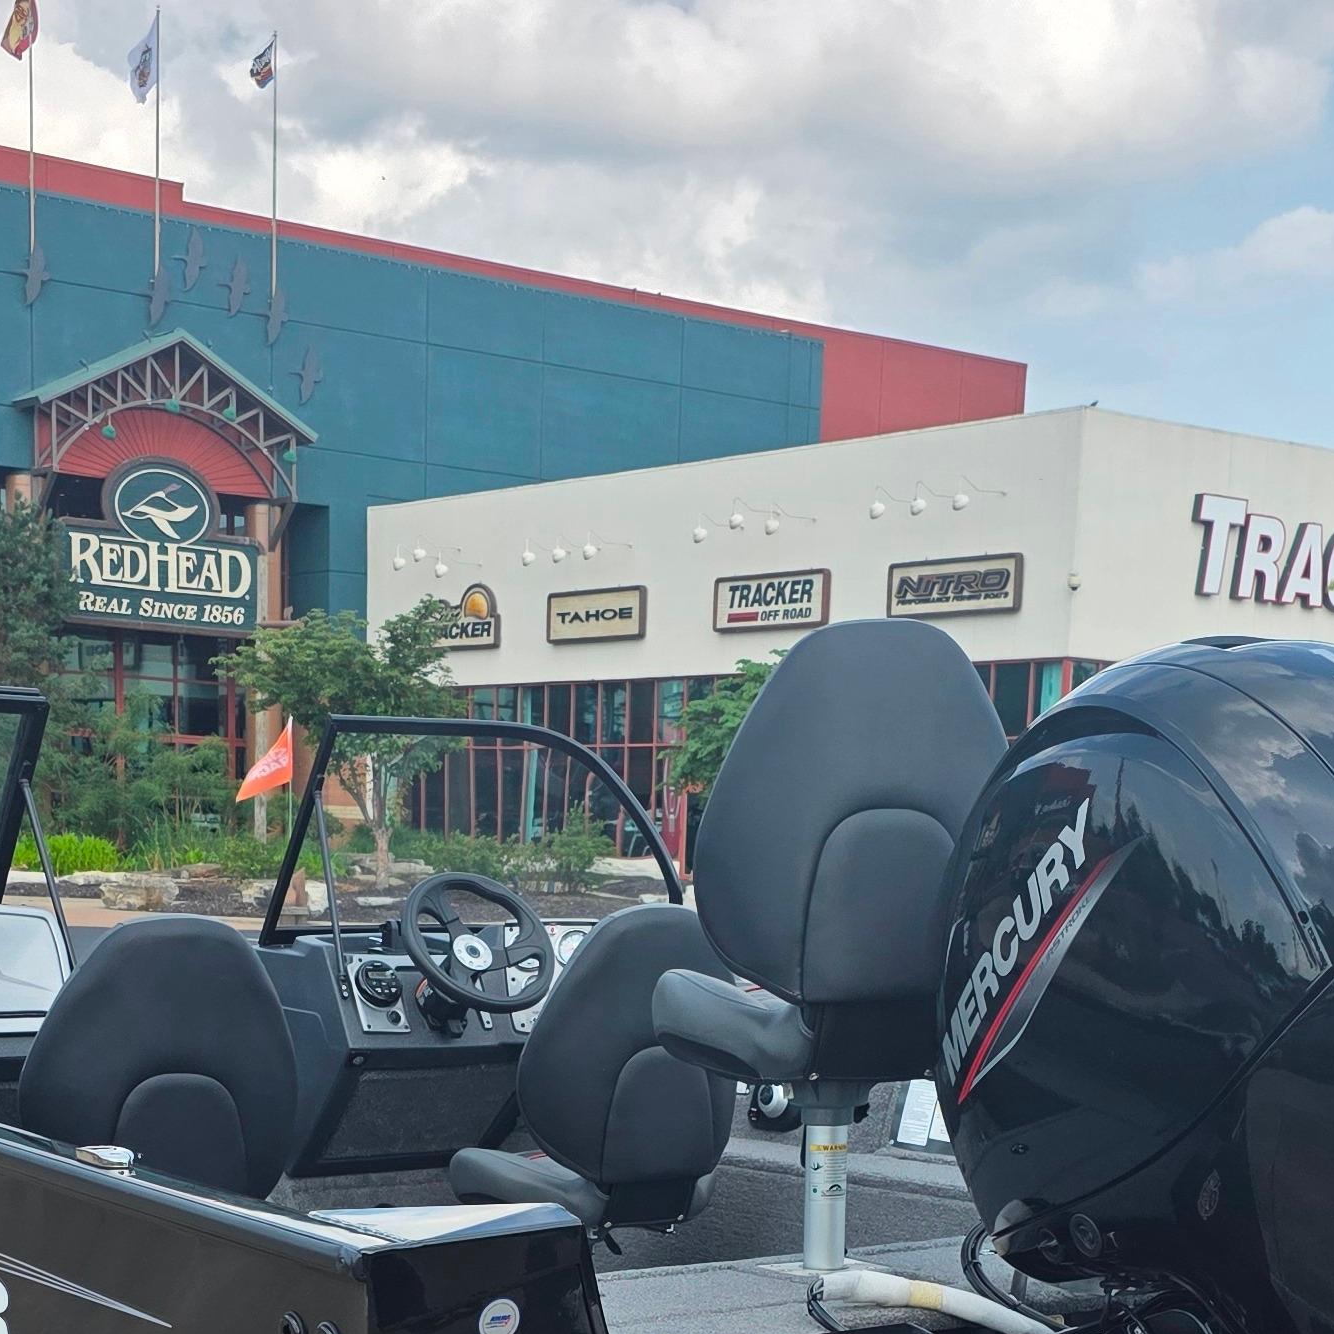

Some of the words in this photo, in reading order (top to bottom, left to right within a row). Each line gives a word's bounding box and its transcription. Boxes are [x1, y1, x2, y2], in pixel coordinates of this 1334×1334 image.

[728, 579, 814, 608] TRACKER
[78, 591, 132, 615] REAL
[139, 597, 198, 621] SINCE
[201, 604, 245, 625] 1856
[556, 606, 633, 624] TAHOE
[760, 609, 780, 621] OFF
[782, 607, 812, 620] ROAD
[437, 621, 491, 642] ACKER
[942, 797, 1090, 1087] MERCURY
